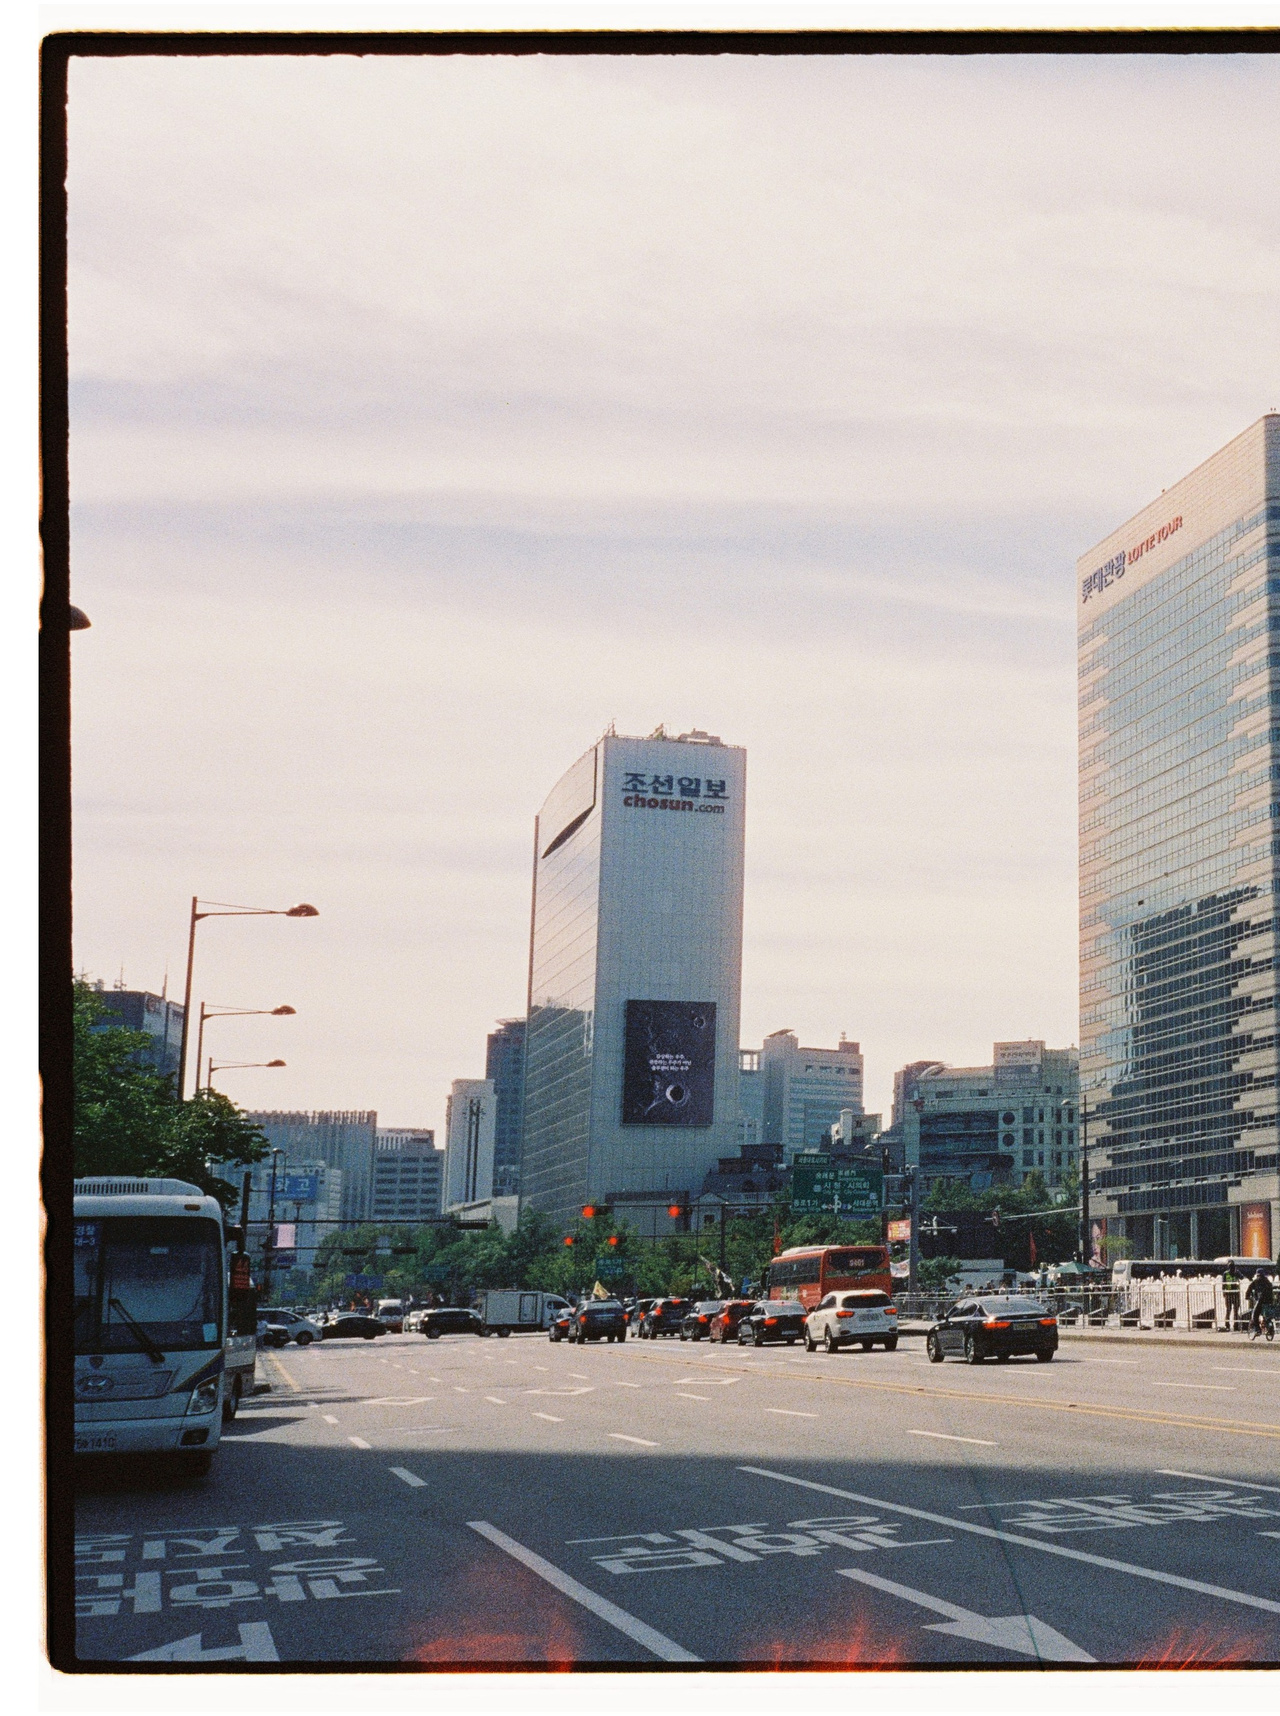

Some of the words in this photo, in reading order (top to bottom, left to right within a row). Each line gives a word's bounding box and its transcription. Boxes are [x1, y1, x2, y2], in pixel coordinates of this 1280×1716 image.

[1082, 549, 1126, 604] 롯데관광
[1127, 533, 1156, 566] LOTTE
[1156, 515, 1183, 544] TOUR
[622, 772, 730, 799] 조선일보
[623, 793, 725, 814] chosun.com
[565, 1516, 955, 1575] 광화문
